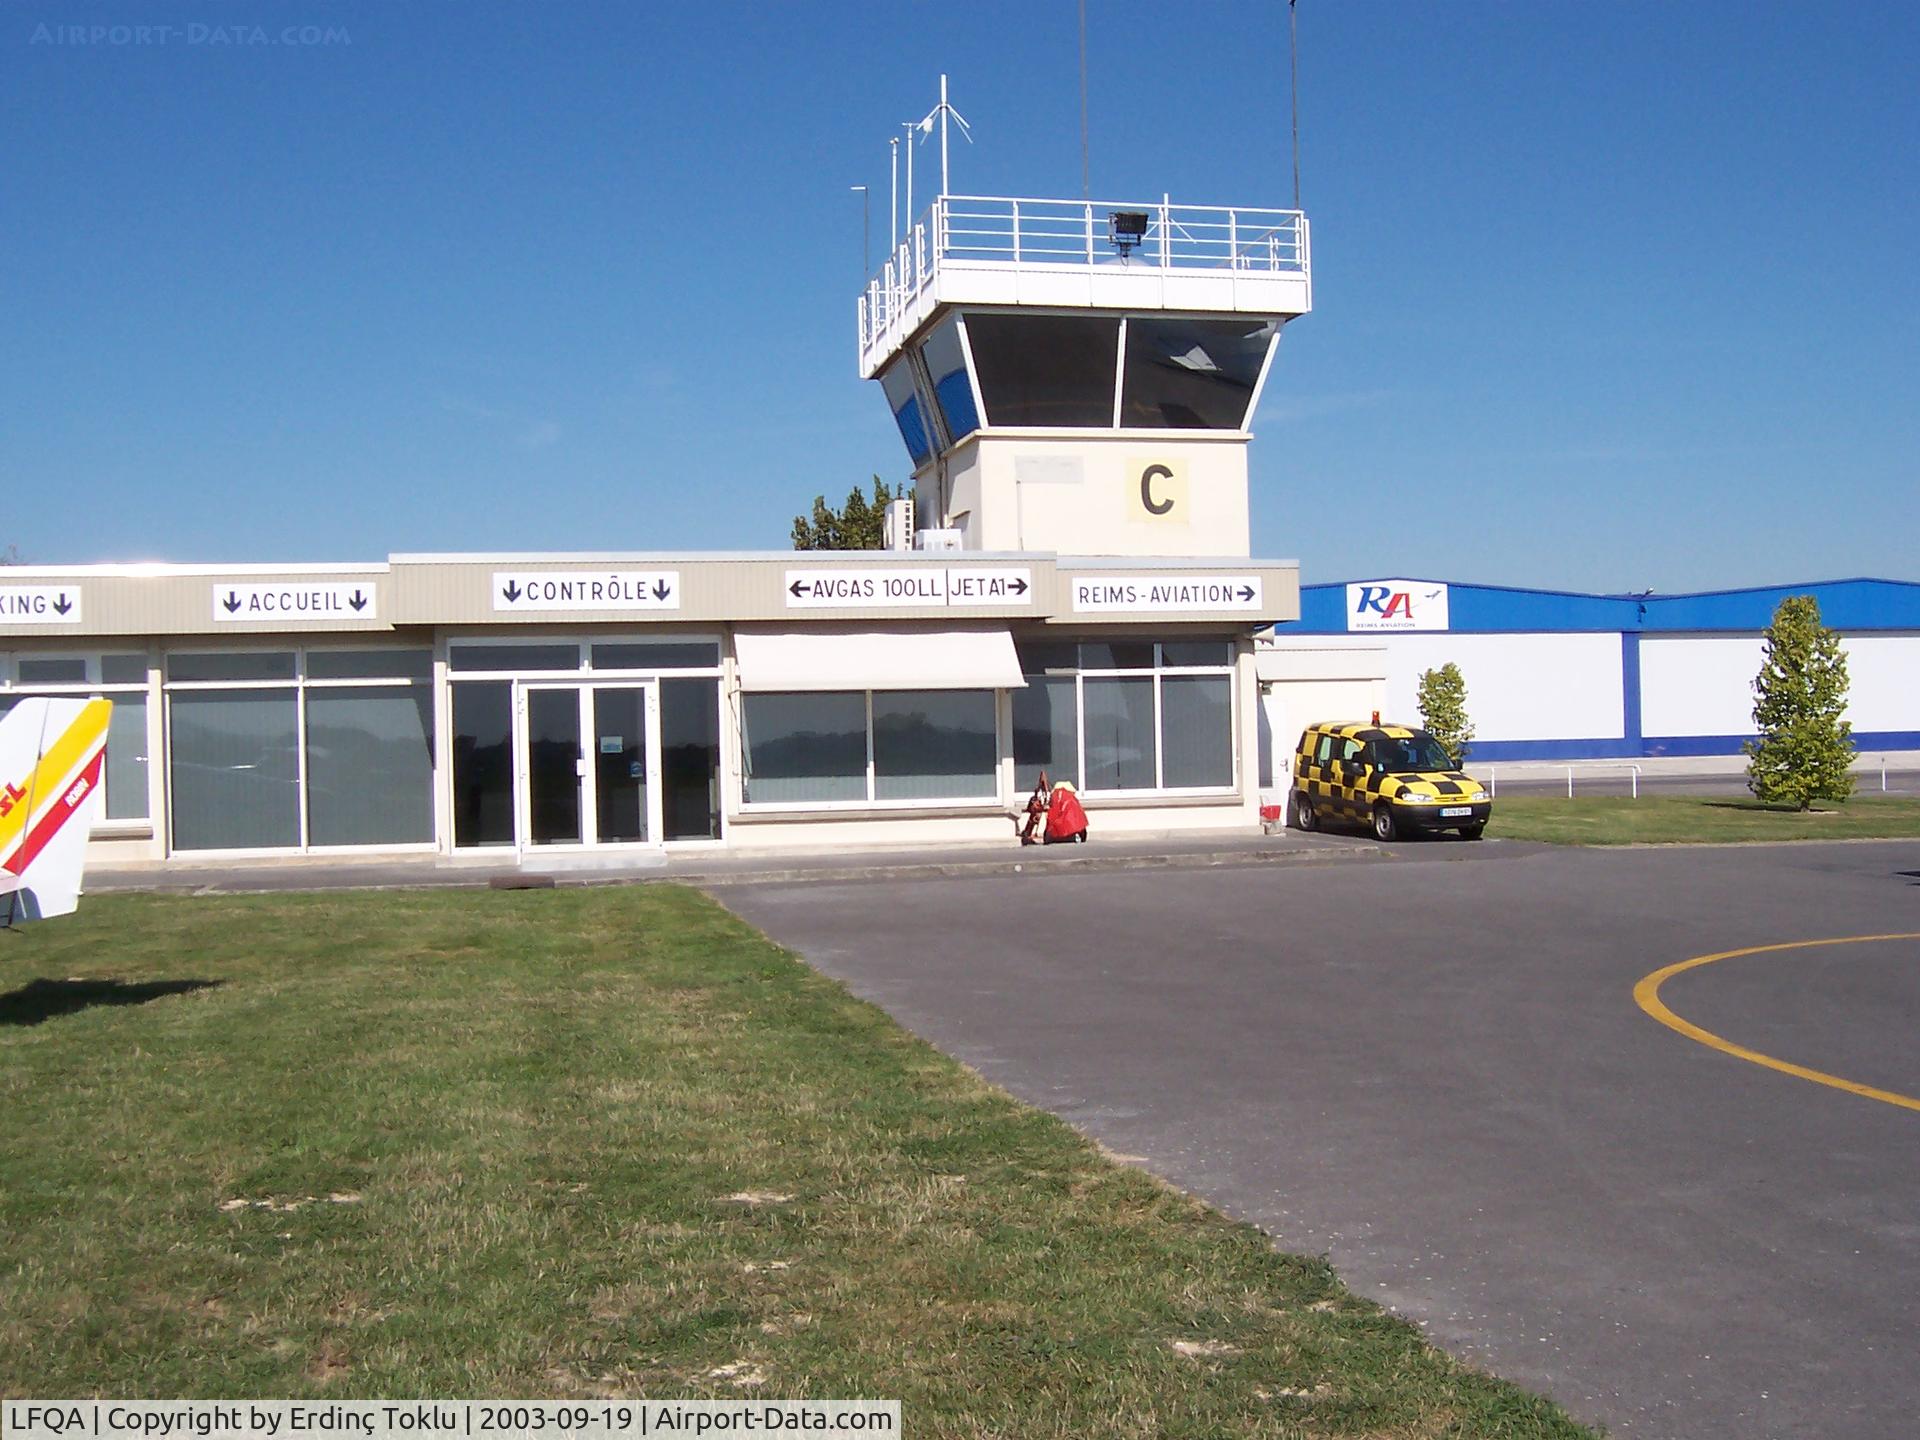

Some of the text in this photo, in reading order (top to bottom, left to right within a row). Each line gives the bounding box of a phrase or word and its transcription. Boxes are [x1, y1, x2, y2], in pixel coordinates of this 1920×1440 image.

[1141, 464, 1175, 515] C
[527, 575, 648, 601] CONTRÔLE
[812, 578, 942, 598] AVGAS 100LL
[249, 591, 343, 612] ACCUEIL
